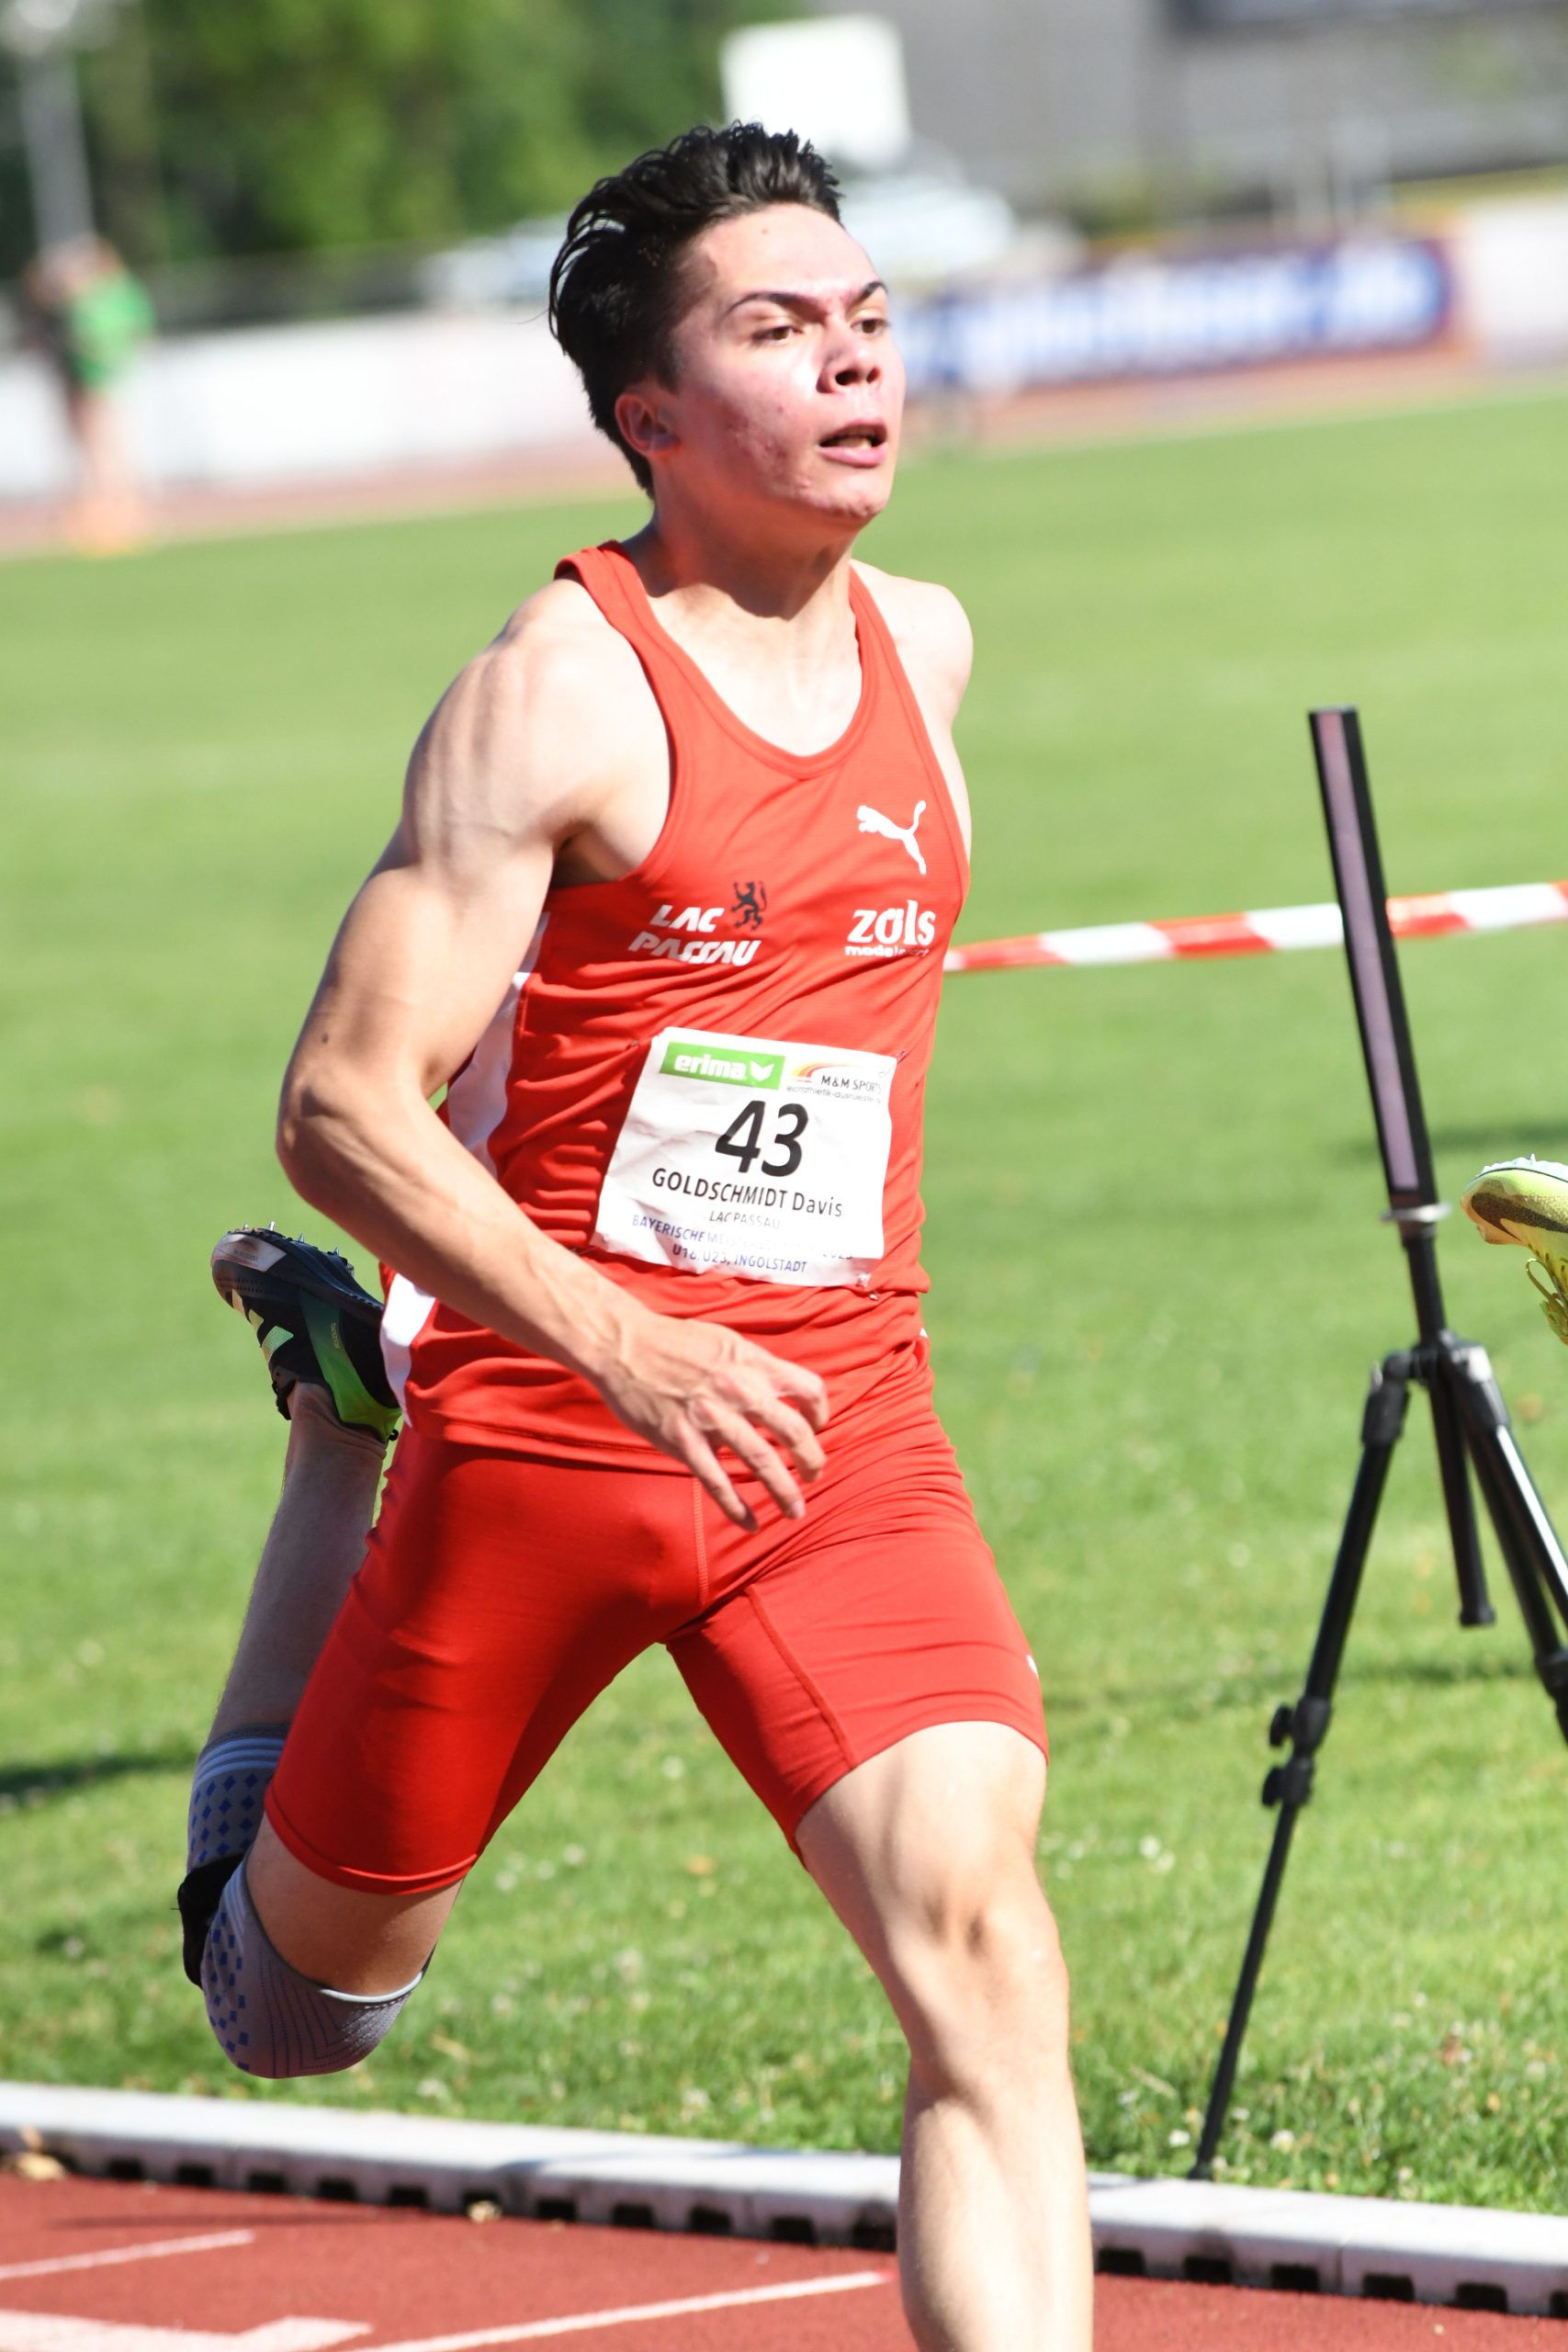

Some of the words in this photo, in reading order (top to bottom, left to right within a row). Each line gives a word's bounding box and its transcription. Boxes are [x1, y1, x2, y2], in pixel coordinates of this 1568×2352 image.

[649, 904, 725, 933] LAC
[628, 932, 761, 967] PASSAU
[673, 1053, 748, 1080] erima
[715, 1100, 808, 1178] 43
[652, 1167, 788, 1210] GOLDSCHMIDT
[792, 1192, 842, 1217] Davis
[632, 1215, 705, 1242] BAYERISCHE
[709, 1210, 732, 1224] LAC
[733, 1213, 781, 1230] PASSAU
[734, 1253, 809, 1273] INGOLSTADT
